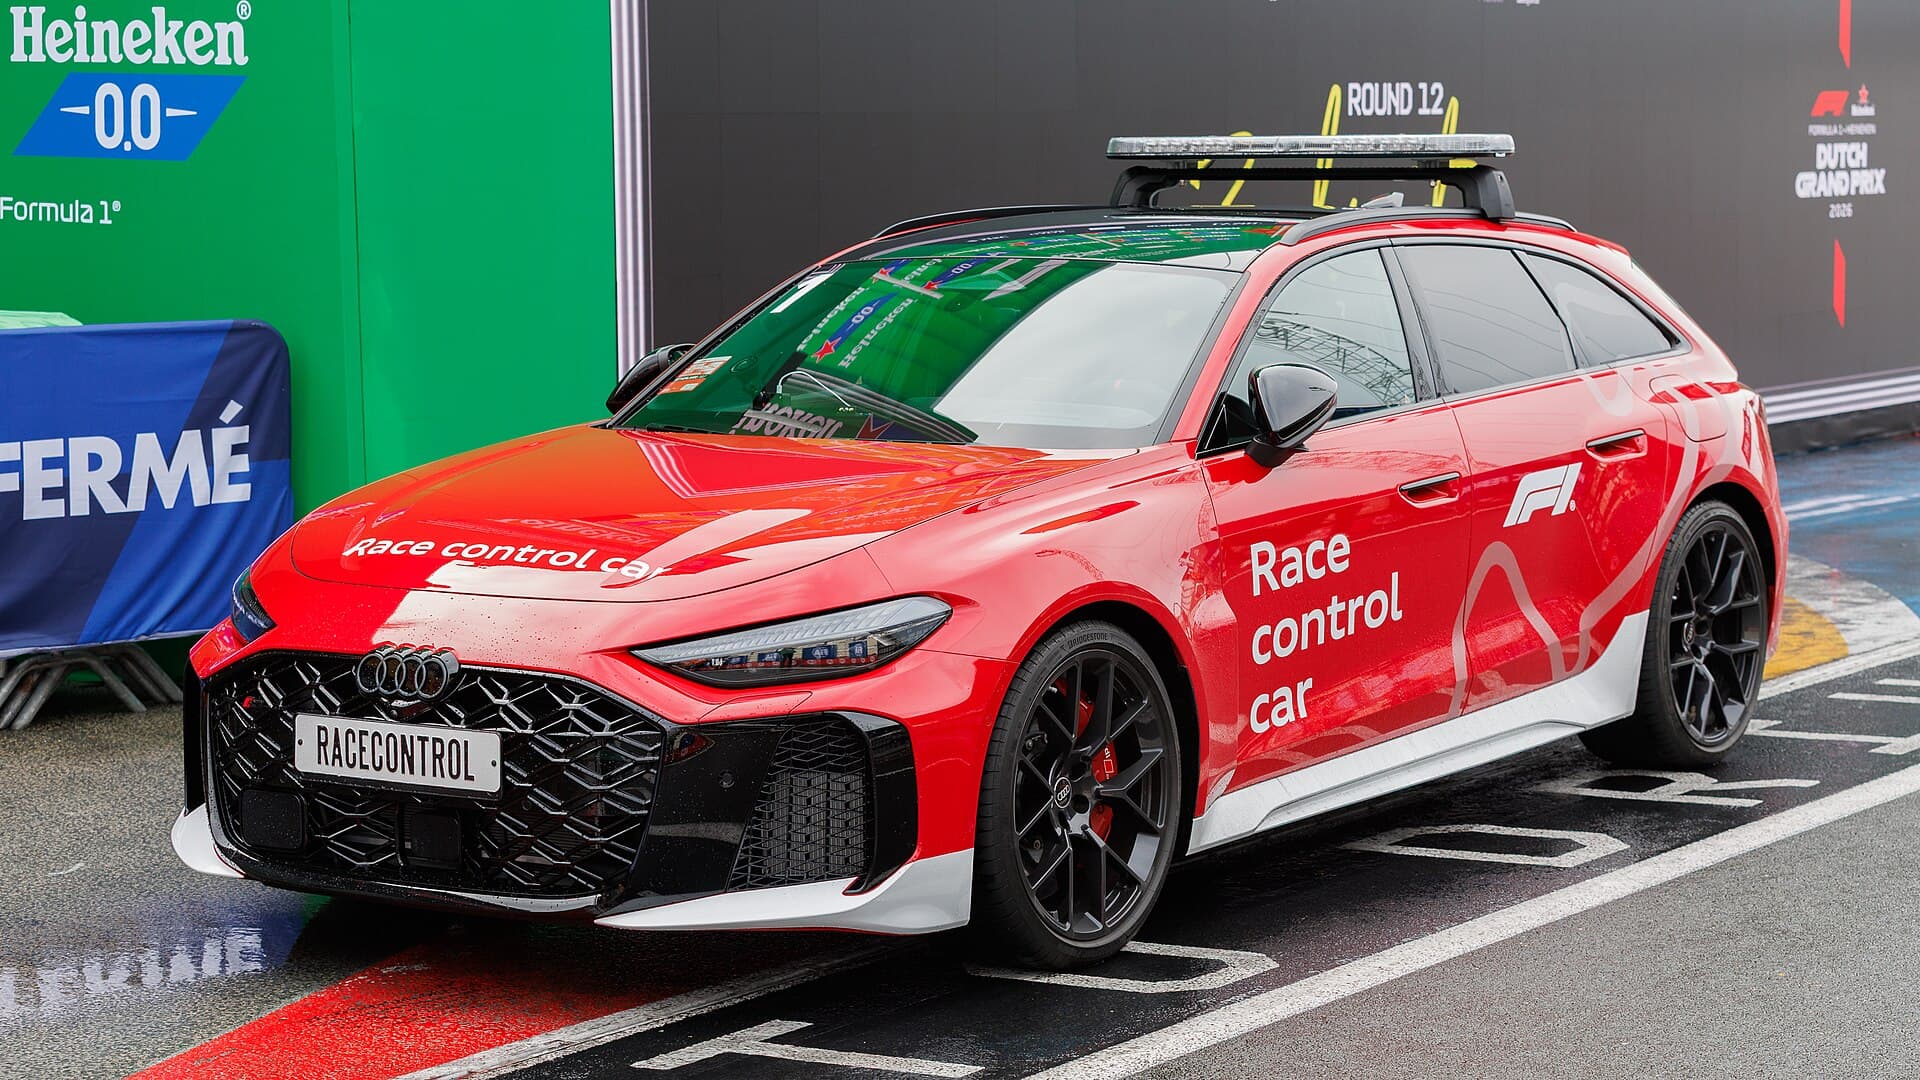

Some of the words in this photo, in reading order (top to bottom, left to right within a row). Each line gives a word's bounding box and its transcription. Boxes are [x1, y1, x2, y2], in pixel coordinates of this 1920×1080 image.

[1348, 82, 1413, 116] ROUND
[1417, 82, 1445, 115] 12
[1816, 142, 1868, 170] DUTCH
[1795, 170, 1850, 199] GRAND
[1850, 168, 1886, 196] PRIX
[0, 196, 94, 224] Formula
[1829, 202, 1853, 219] 2026
[343, 537, 434, 558] Race
[440, 539, 597, 569] control
[600, 556, 672, 581] car
[1251, 533, 1351, 598] Race
[1251, 572, 1403, 666] control
[1251, 678, 1314, 734] car
[317, 723, 475, 783] RACECONTROL
